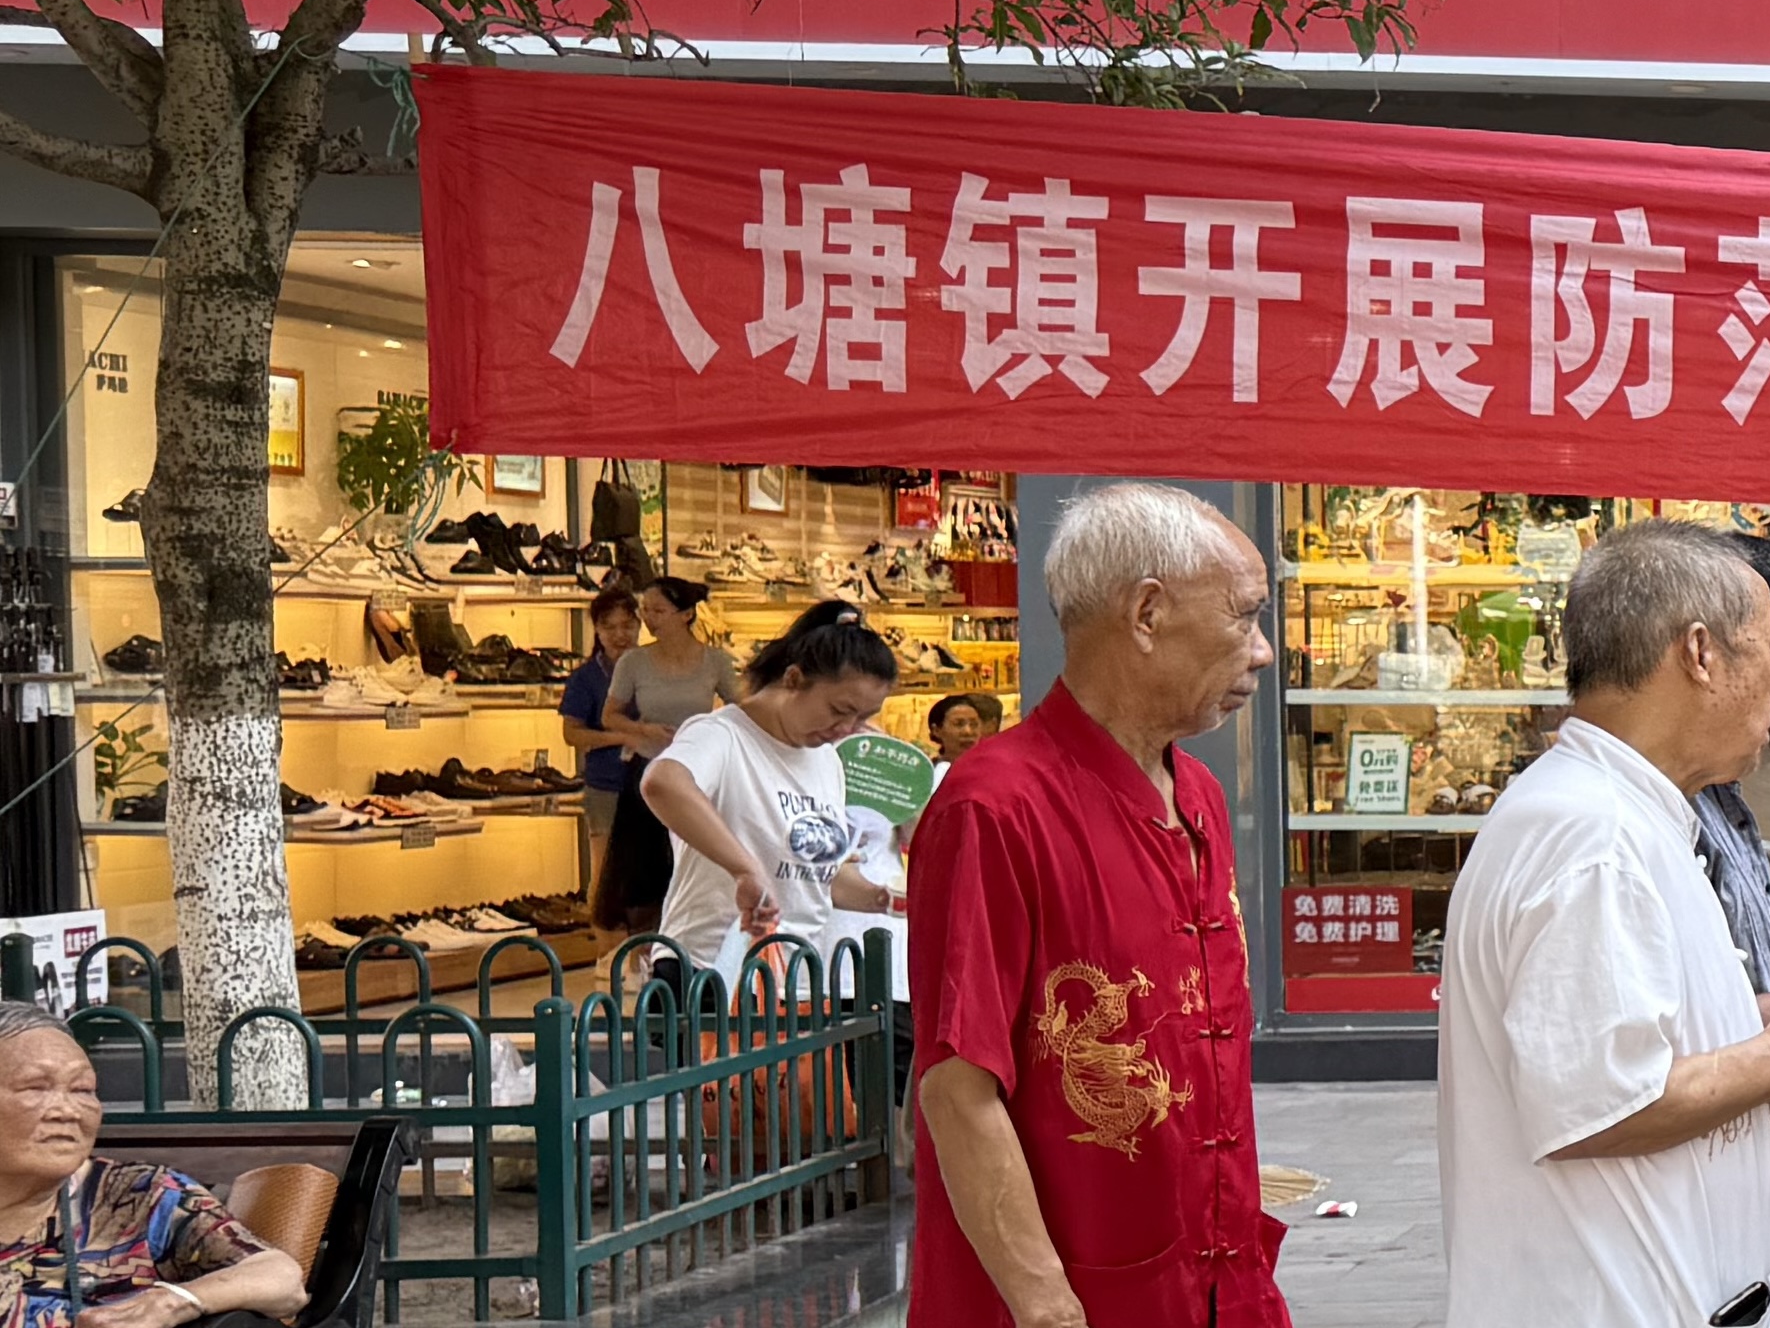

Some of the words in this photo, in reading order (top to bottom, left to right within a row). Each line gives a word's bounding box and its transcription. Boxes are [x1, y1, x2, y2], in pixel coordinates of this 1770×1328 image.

[1293, 893, 1400, 917] 免费清洗
[1293, 920, 1401, 944] 免费护理
